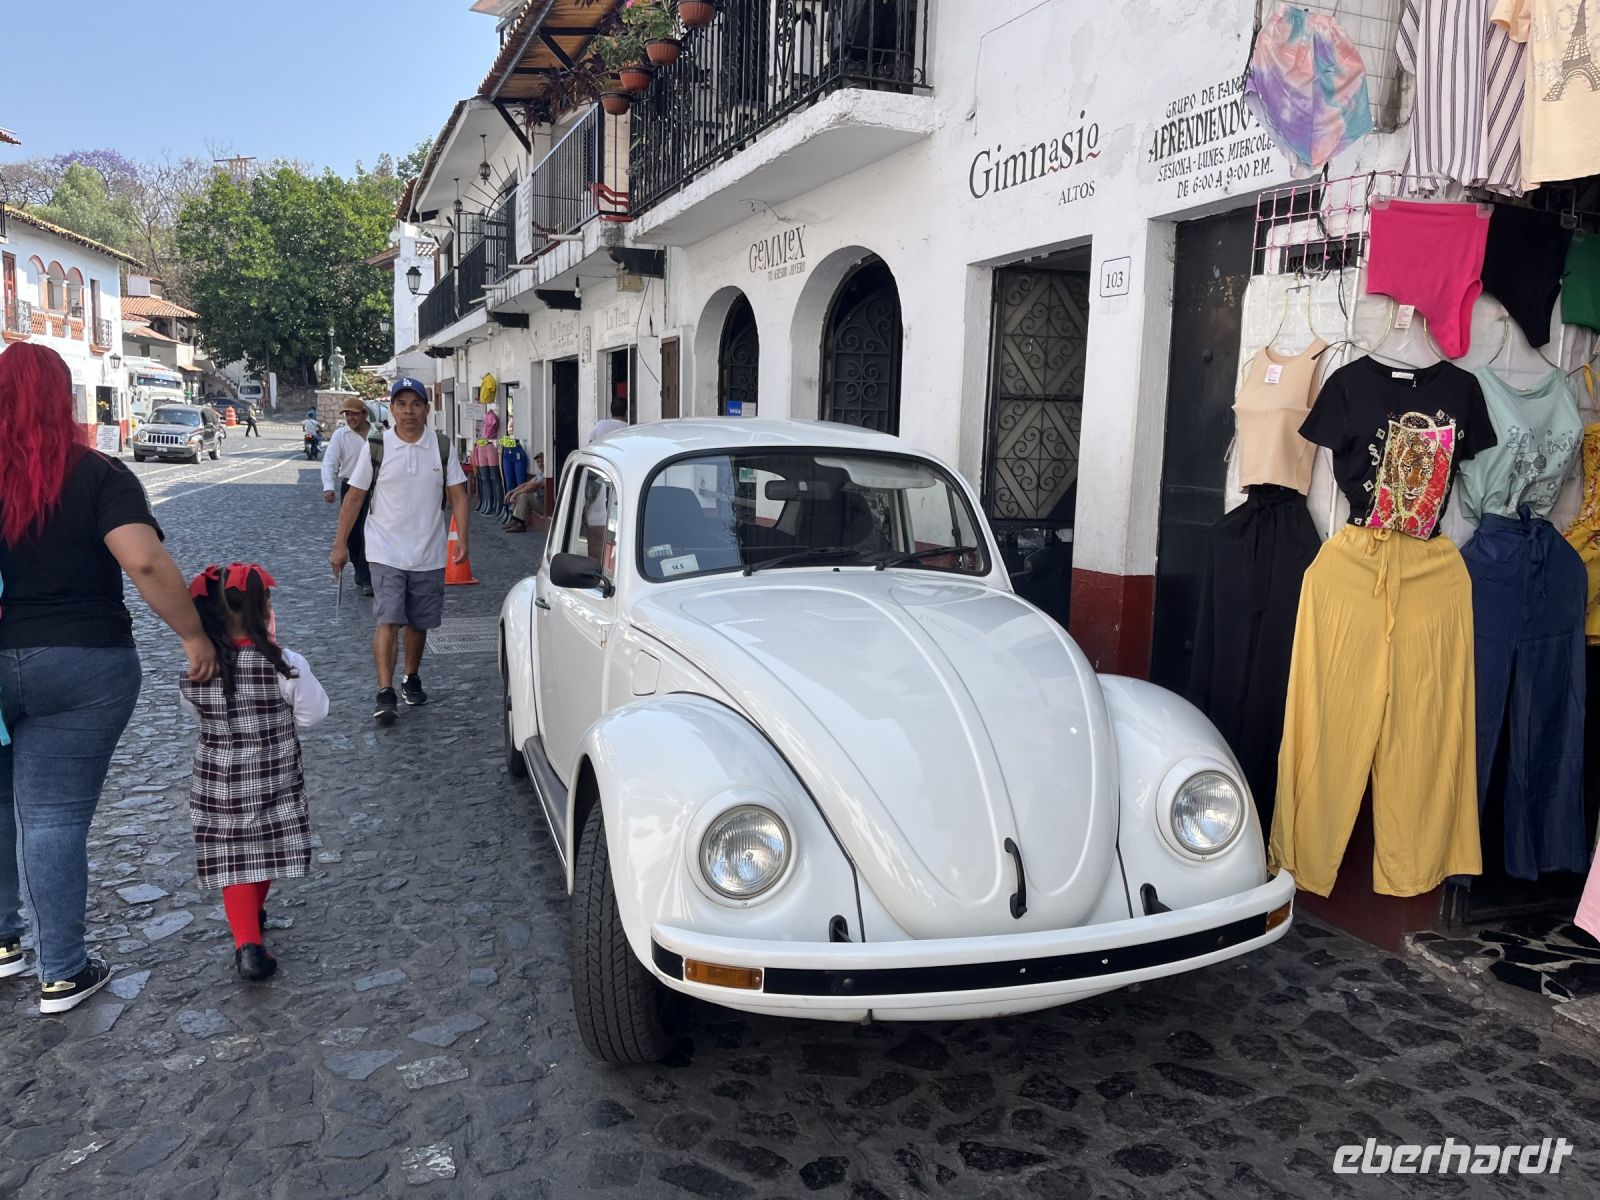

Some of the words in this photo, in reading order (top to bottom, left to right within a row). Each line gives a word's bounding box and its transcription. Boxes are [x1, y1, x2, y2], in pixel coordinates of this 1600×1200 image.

[1165, 93, 1196, 118] GRUPO
[1201, 86, 1215, 105] DE
[1148, 95, 1250, 163] APRENDIENDO
[969, 110, 1100, 199] Gimnasio
[1228, 133, 1275, 162] MIERCOLE
[1058, 180, 1095, 205] ALTOS
[1177, 180, 1189, 198] DE
[1193, 173, 1213, 193] 6:00
[1215, 170, 1222, 188] A
[1227, 162, 1250, 184] 9:00
[1253, 156, 1273, 177] P.M.
[1105, 271, 1123, 288] 103
